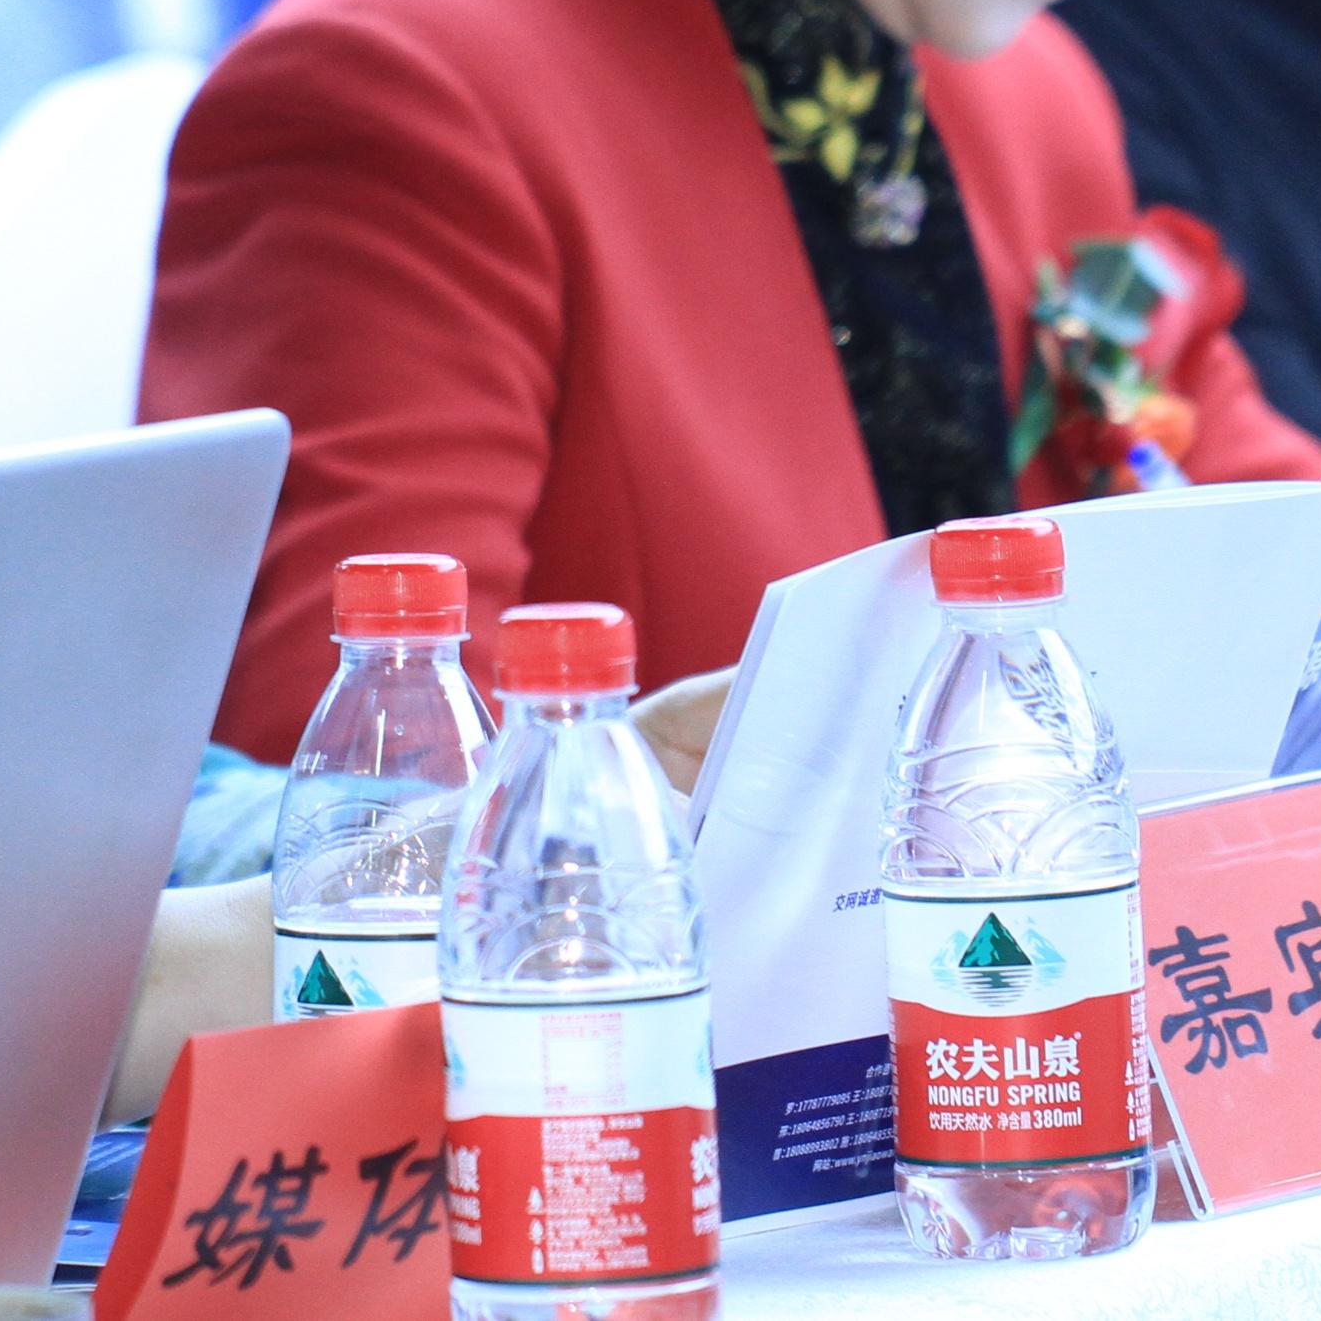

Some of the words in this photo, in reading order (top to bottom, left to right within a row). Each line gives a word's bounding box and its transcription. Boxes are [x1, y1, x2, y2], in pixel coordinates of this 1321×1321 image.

[925, 1034, 1082, 1081] 农夫山泉
[928, 1084, 1000, 1107] NONGFU
[1006, 1080, 1081, 1106] SPRING
[929, 1111, 993, 1132] 饮用天然水
[997, 1106, 1082, 1131] 净含量380ml
[161, 1131, 450, 1292] 媒体
